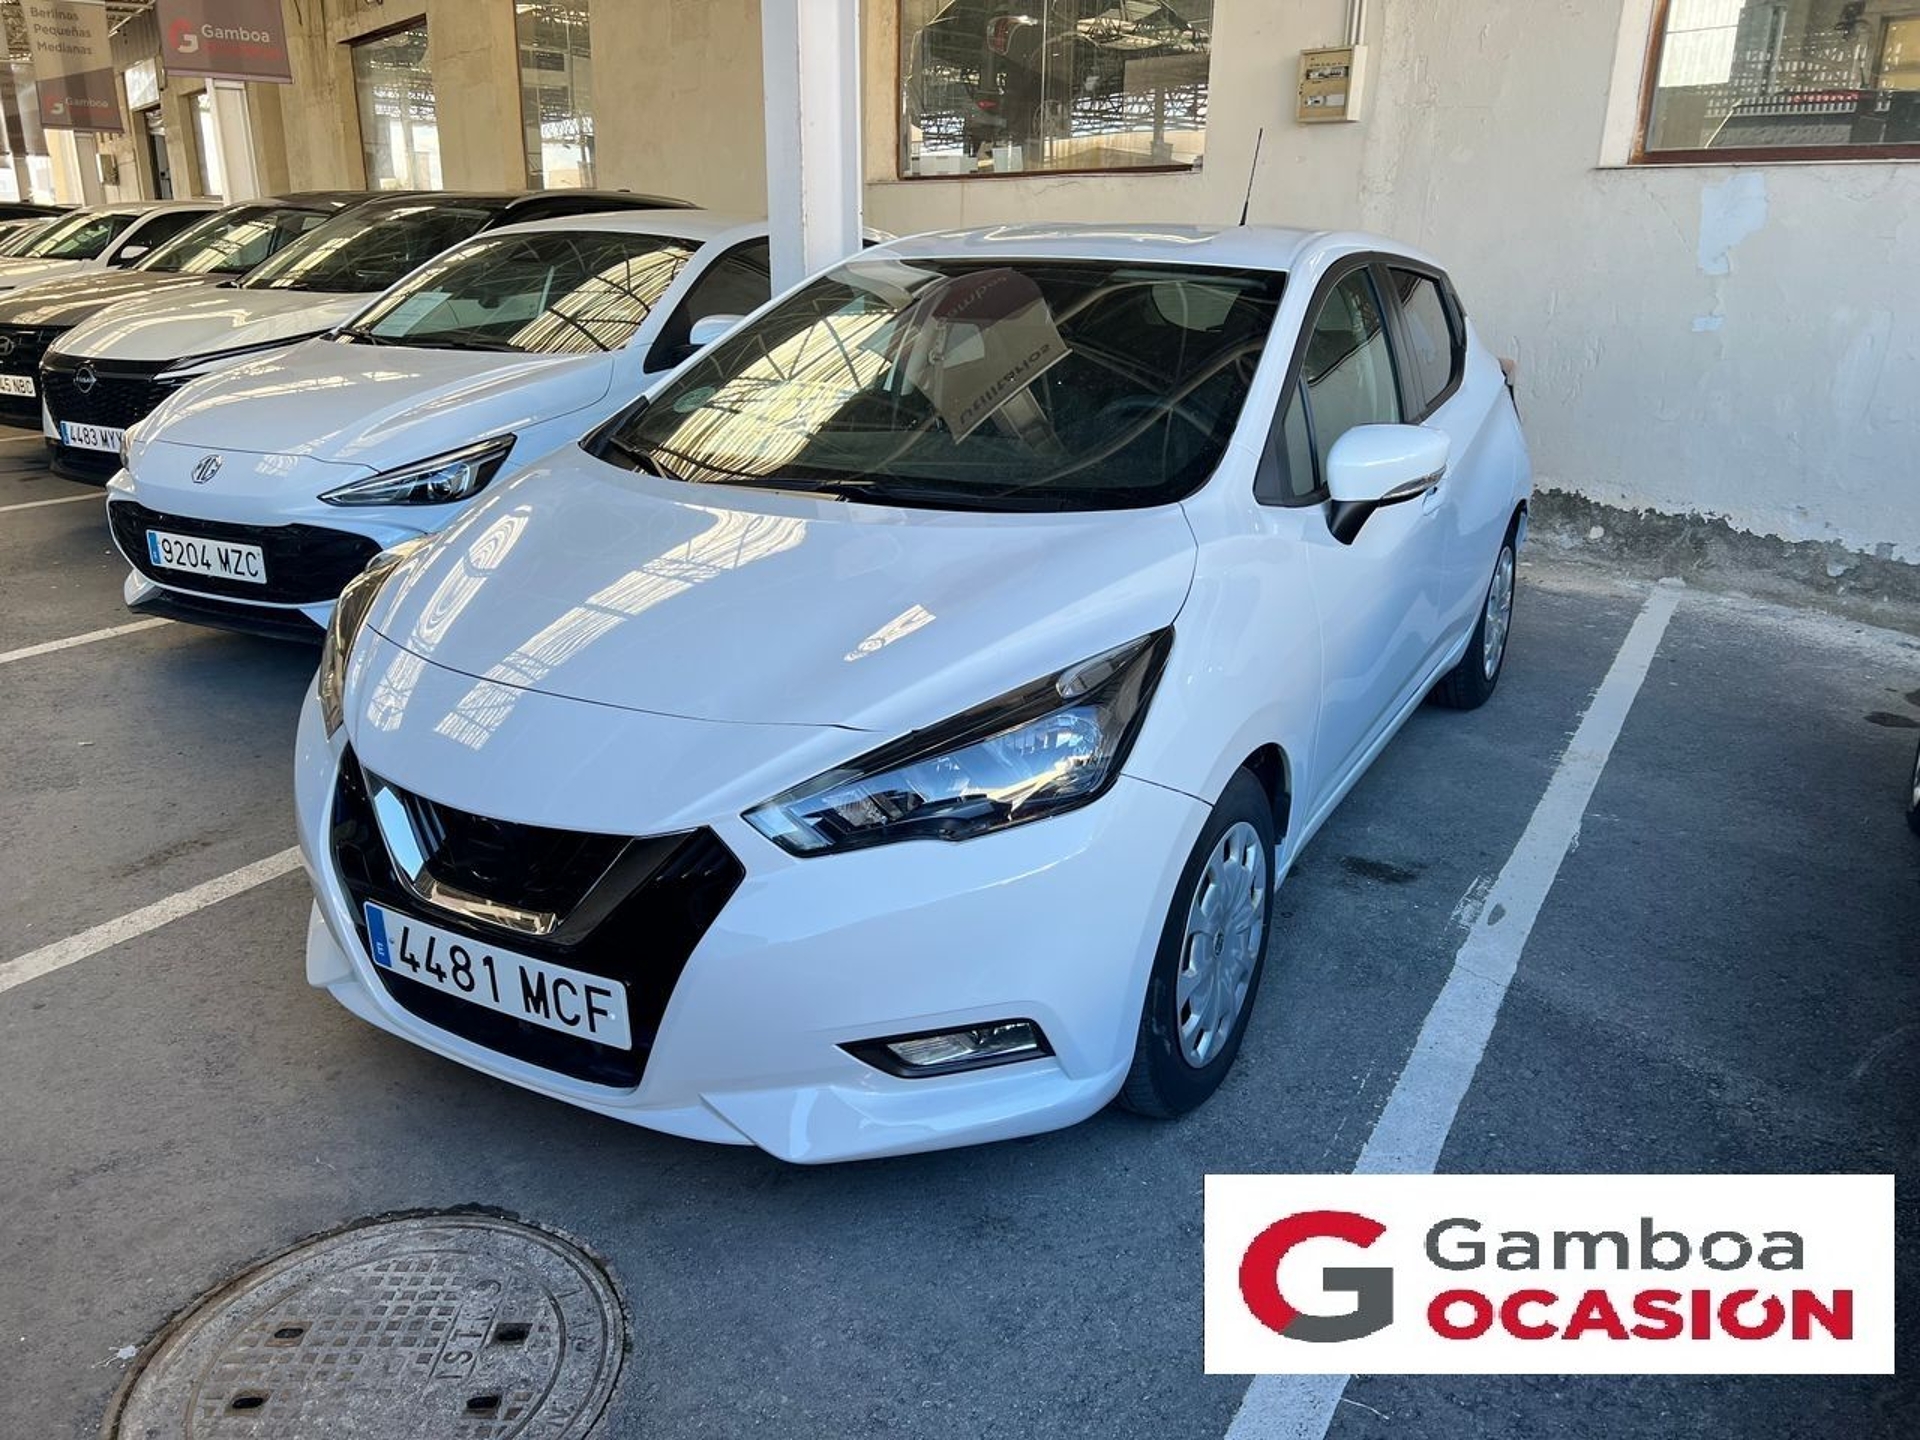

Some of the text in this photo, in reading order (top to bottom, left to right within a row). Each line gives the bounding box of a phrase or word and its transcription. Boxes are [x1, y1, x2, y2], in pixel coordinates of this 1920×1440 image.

[201, 23, 270, 43] Gamboa
[70, 425, 98, 447] 4483
[162, 538, 259, 577] 9204 MZC
[399, 926, 612, 1033] 4481 MCF
